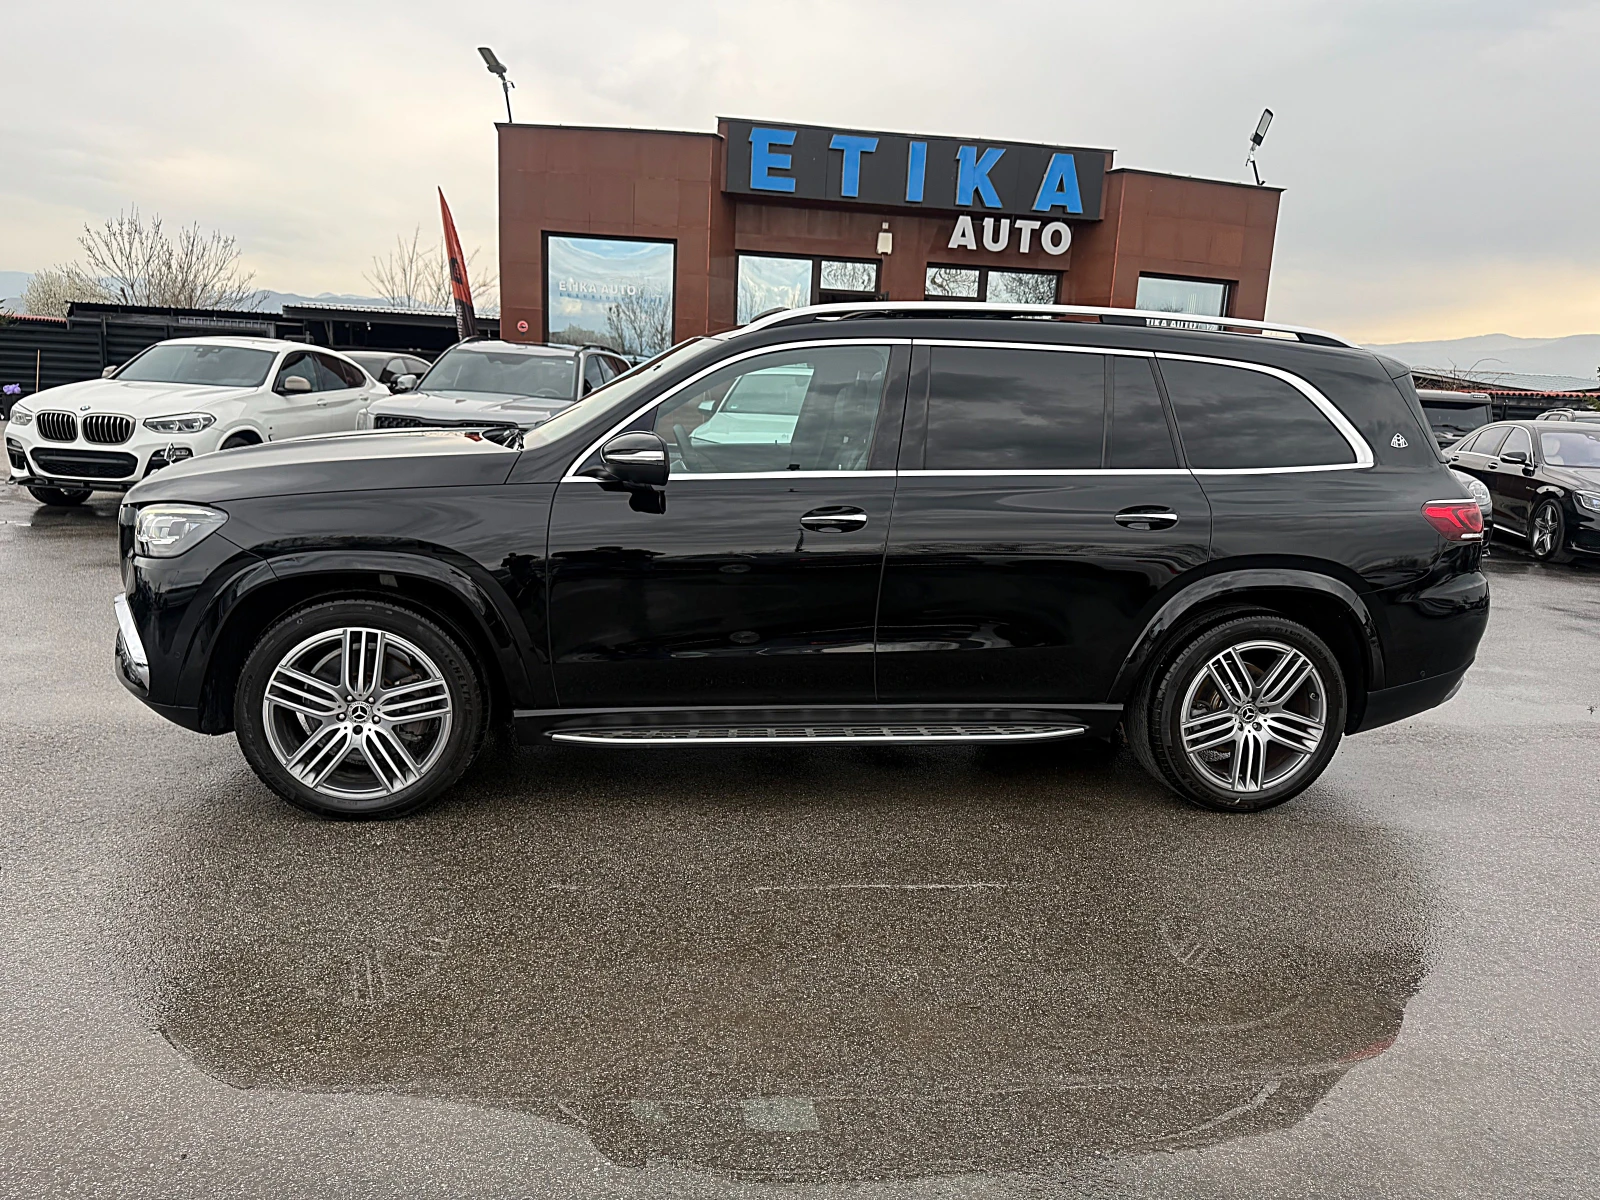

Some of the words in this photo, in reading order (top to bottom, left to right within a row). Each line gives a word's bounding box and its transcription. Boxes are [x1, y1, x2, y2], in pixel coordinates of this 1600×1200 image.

[748, 127, 1083, 214] ETIKA
[947, 215, 1072, 256] AUTO
[600, 283, 636, 296] AUTO
[1145, 318, 1167, 327] TIKA
